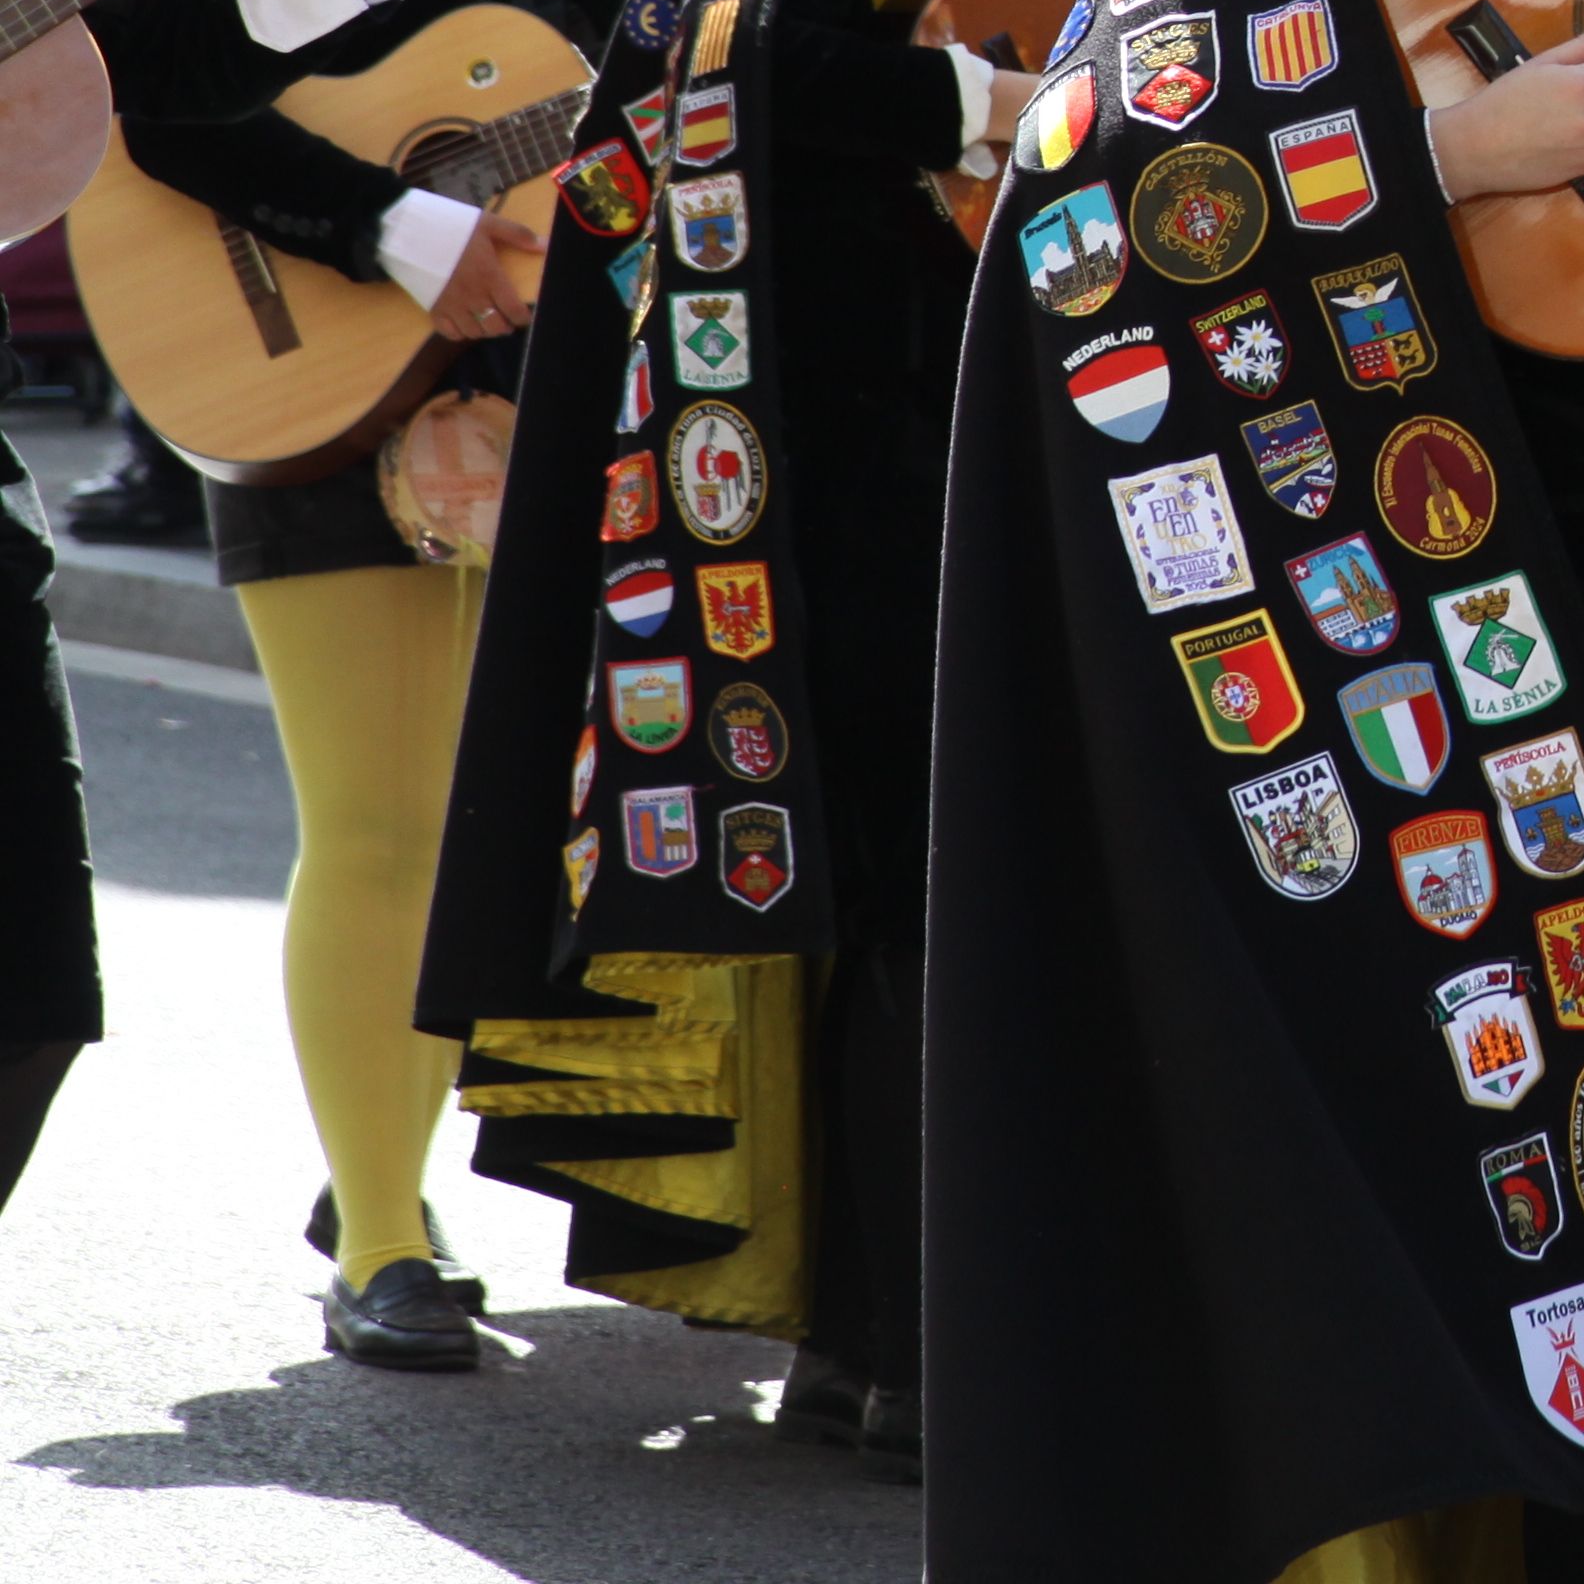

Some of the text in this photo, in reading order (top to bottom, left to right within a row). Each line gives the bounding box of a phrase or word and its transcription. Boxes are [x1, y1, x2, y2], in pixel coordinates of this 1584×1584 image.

[1256, 2, 1322, 28] CATALUNYA
[1131, 22, 1210, 52] SITGES
[1280, 121, 1350, 148] ESPAÑA
[1146, 151, 1229, 191] CASTELLÓN
[1195, 294, 1267, 334] SWITZERLAND
[1061, 325, 1154, 372] NEDERLAND
[1257, 410, 1302, 436] BASEL
[1420, 536, 1466, 553] Carmona
[604, 557, 667, 587] NEDERLAND
[1185, 624, 1262, 657] PORTUGAL
[1349, 666, 1430, 713] ITALIA
[1474, 698, 1498, 715] LA
[1241, 763, 1329, 810] LISBOA
[1399, 817, 1481, 854] FIRENZE
[1439, 910, 1479, 929] DUOMO
[1486, 1140, 1544, 1176] ROMA
